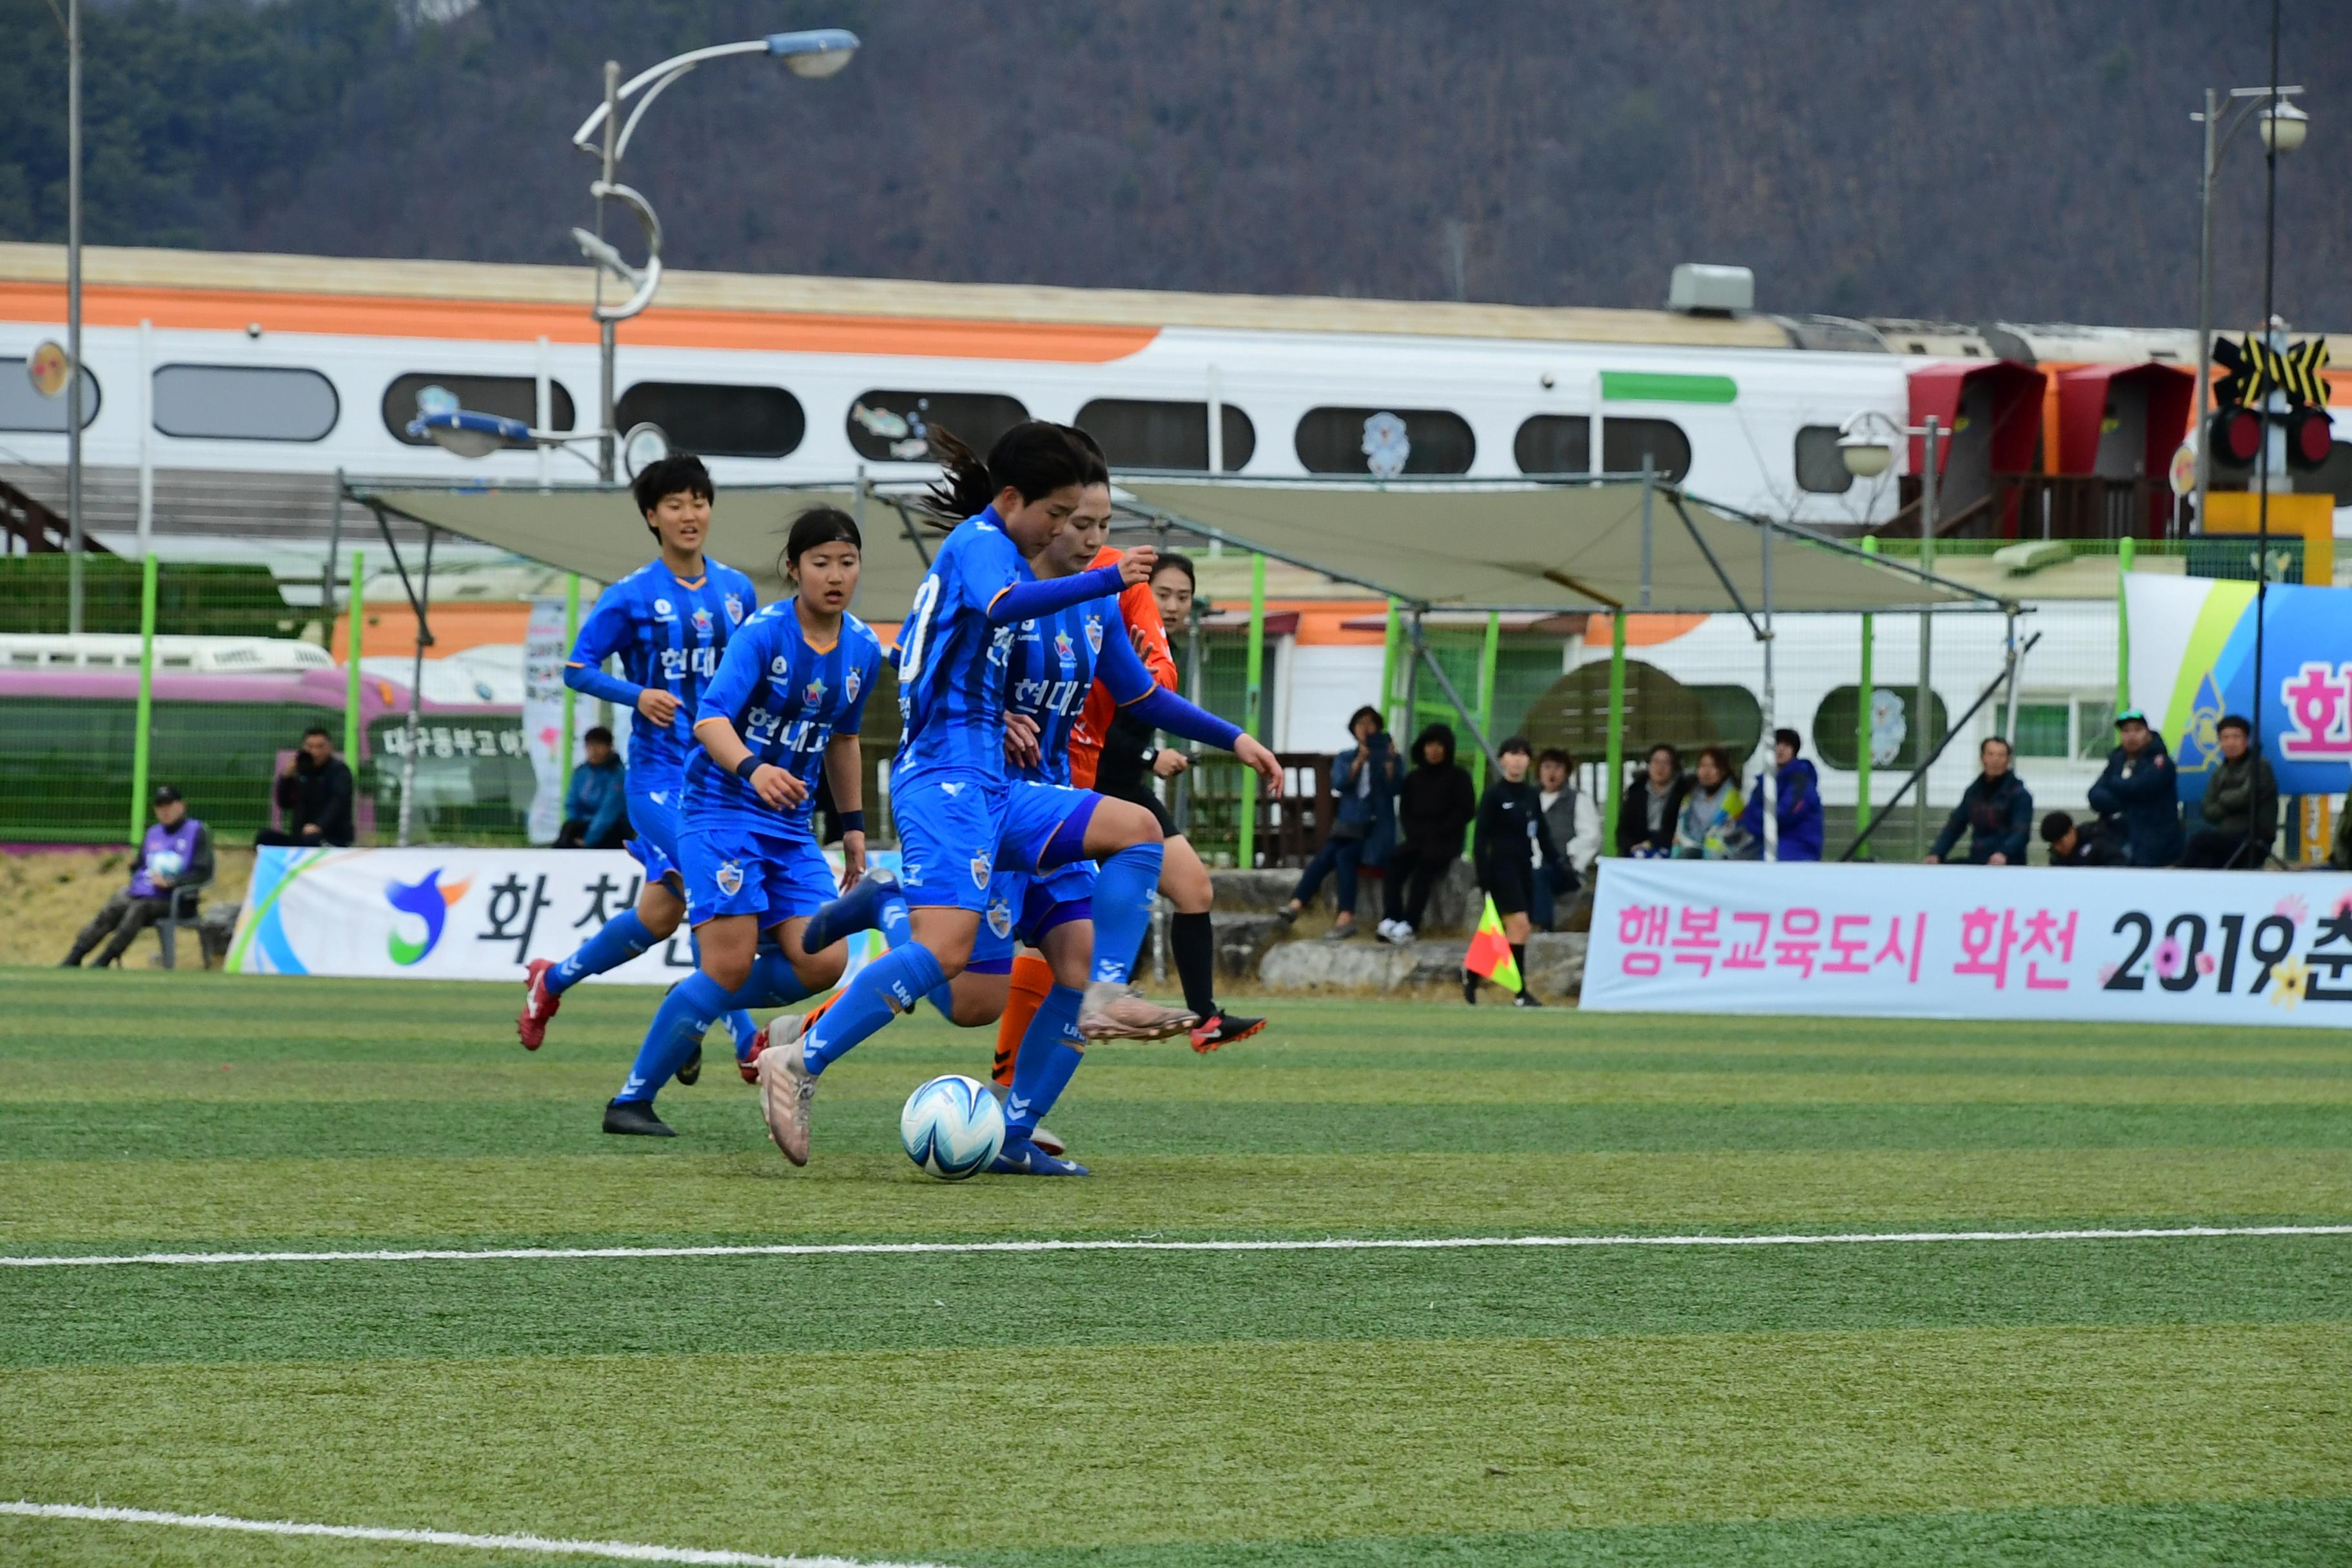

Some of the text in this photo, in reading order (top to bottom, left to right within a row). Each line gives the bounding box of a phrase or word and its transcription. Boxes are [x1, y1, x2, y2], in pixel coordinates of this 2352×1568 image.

[660, 646, 727, 680] 현대
[1617, 905, 1928, 983] 행복교육도시
[1953, 906, 2079, 990] 화천
